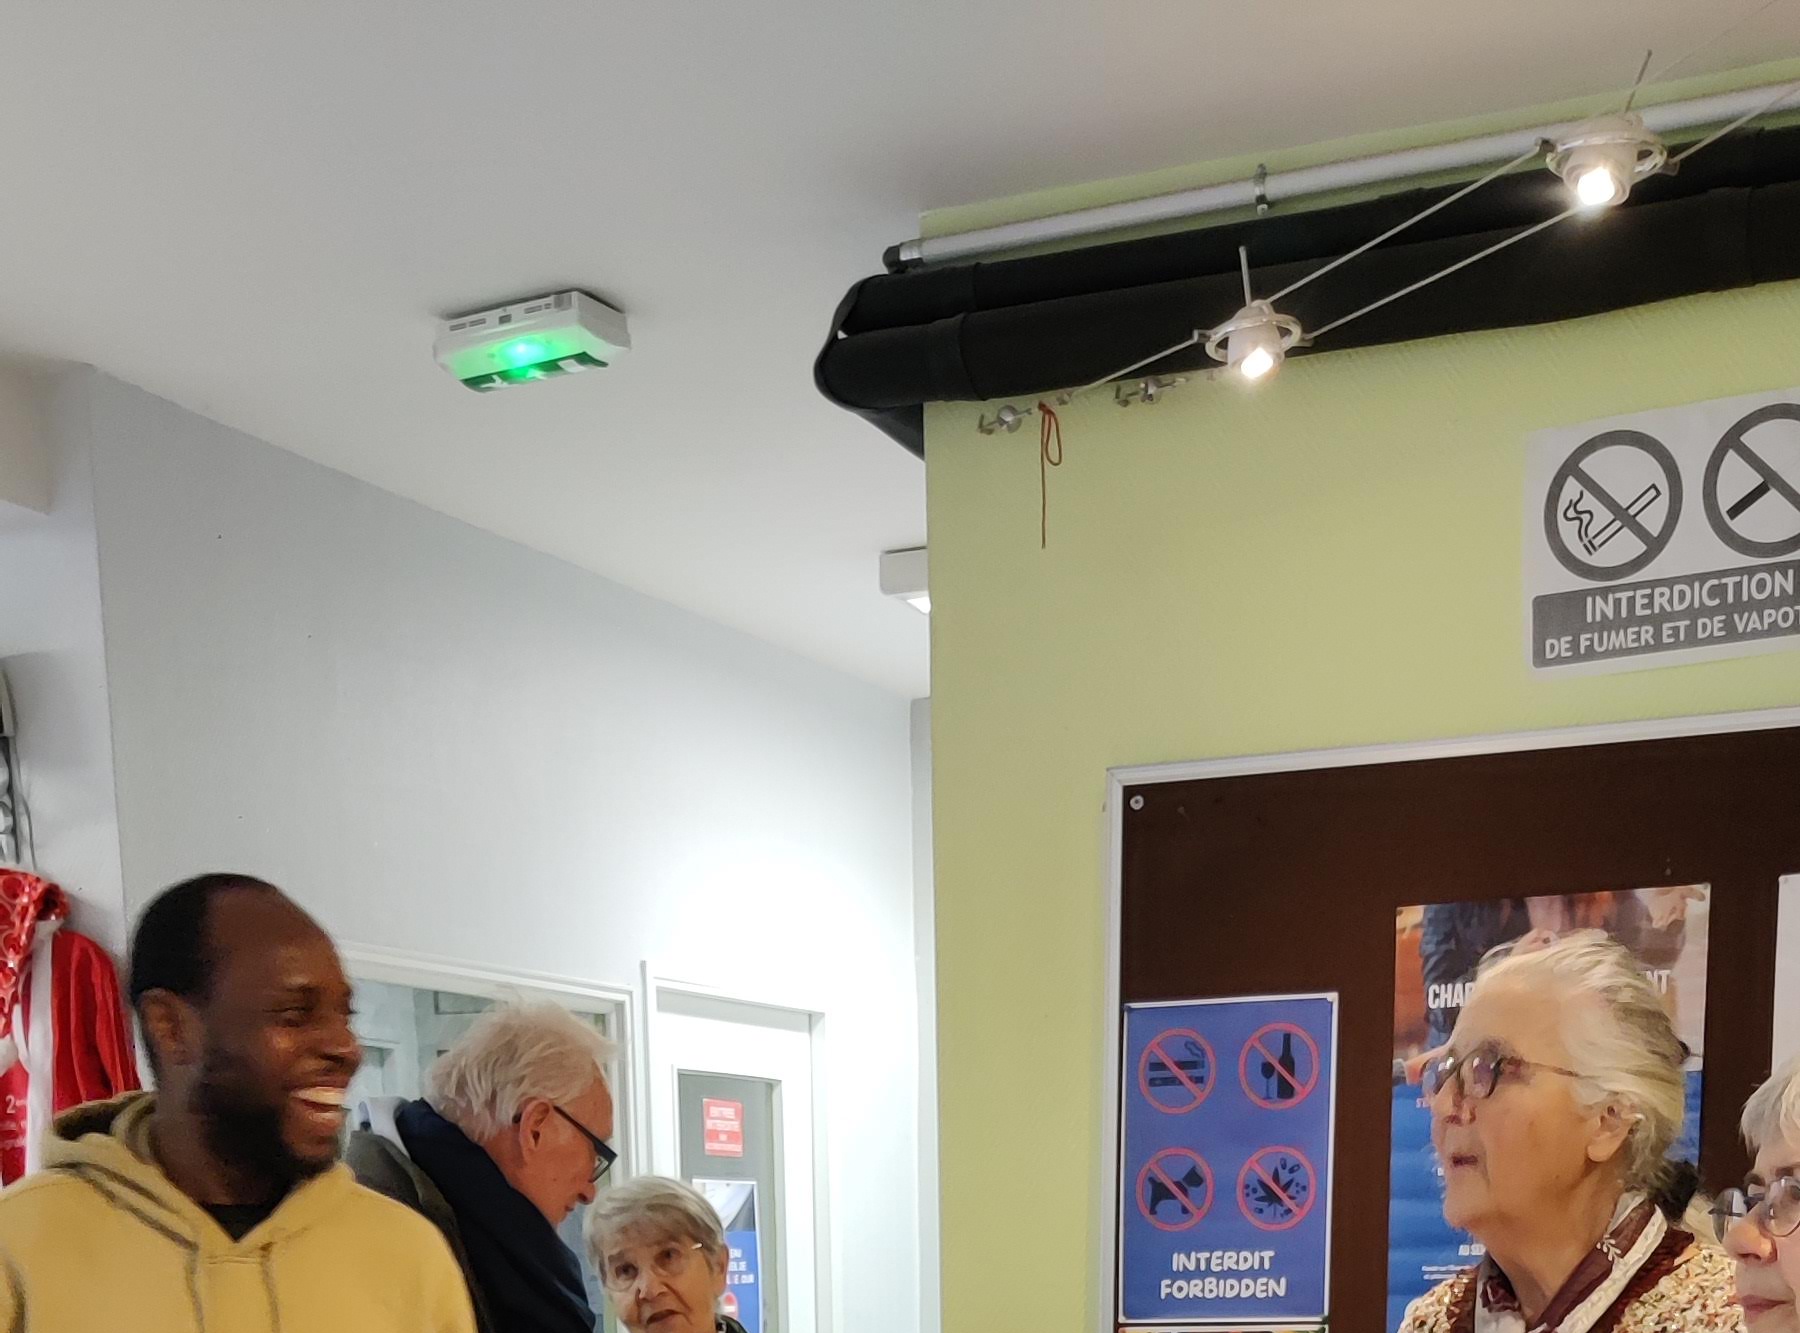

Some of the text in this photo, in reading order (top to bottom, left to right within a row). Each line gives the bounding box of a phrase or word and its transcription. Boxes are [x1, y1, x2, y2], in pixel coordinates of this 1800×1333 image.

[1586, 569, 1794, 623] INTERDICTION
[1545, 636, 1572, 659] DE
[1579, 625, 1655, 654] FUMER
[1662, 620, 1691, 643] ET
[1697, 614, 1726, 639] DE
[1172, 1250, 1275, 1272] INTERDIT
[1160, 1277, 1287, 1300] FORBIDDEN
